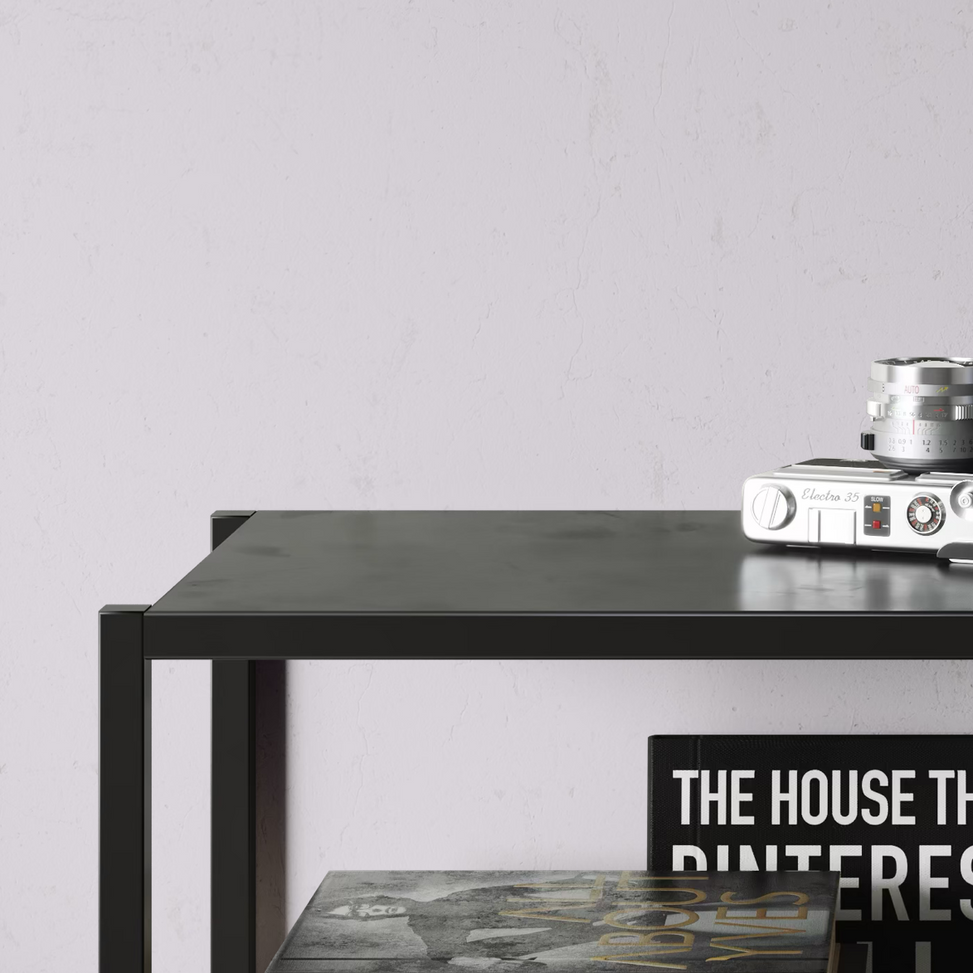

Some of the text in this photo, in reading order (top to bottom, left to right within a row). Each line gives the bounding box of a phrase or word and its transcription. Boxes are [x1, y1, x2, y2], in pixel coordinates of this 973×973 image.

[904, 385, 920, 394] AUTO
[801, 488, 860, 503] Electro 35
[673, 769, 756, 826] THE
[771, 769, 916, 826] HOUSE
[590, 870, 709, 970] ABOUT
[705, 891, 810, 963] YVES
